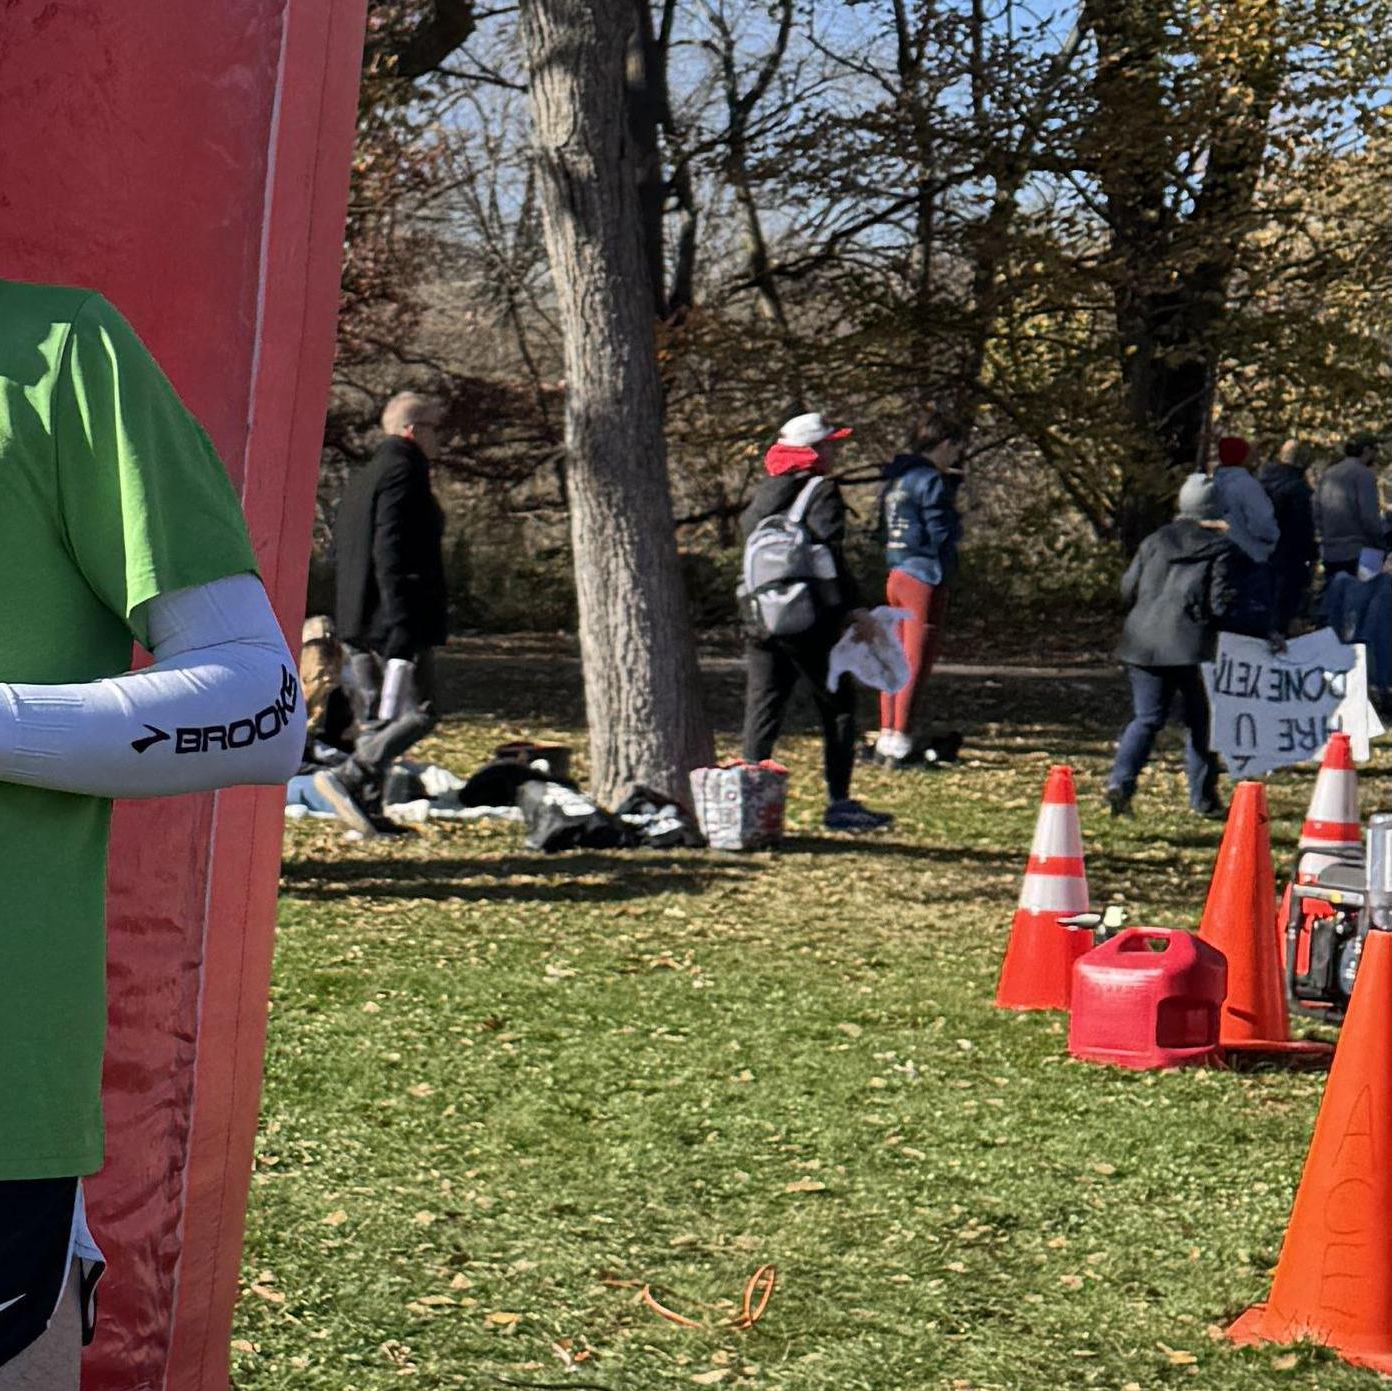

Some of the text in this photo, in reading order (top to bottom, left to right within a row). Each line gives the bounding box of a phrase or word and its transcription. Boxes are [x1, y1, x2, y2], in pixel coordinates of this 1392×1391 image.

[1267, 666, 1346, 702] DONE
[174, 664, 298, 754] BROOKS
[1235, 712, 1257, 748] U
